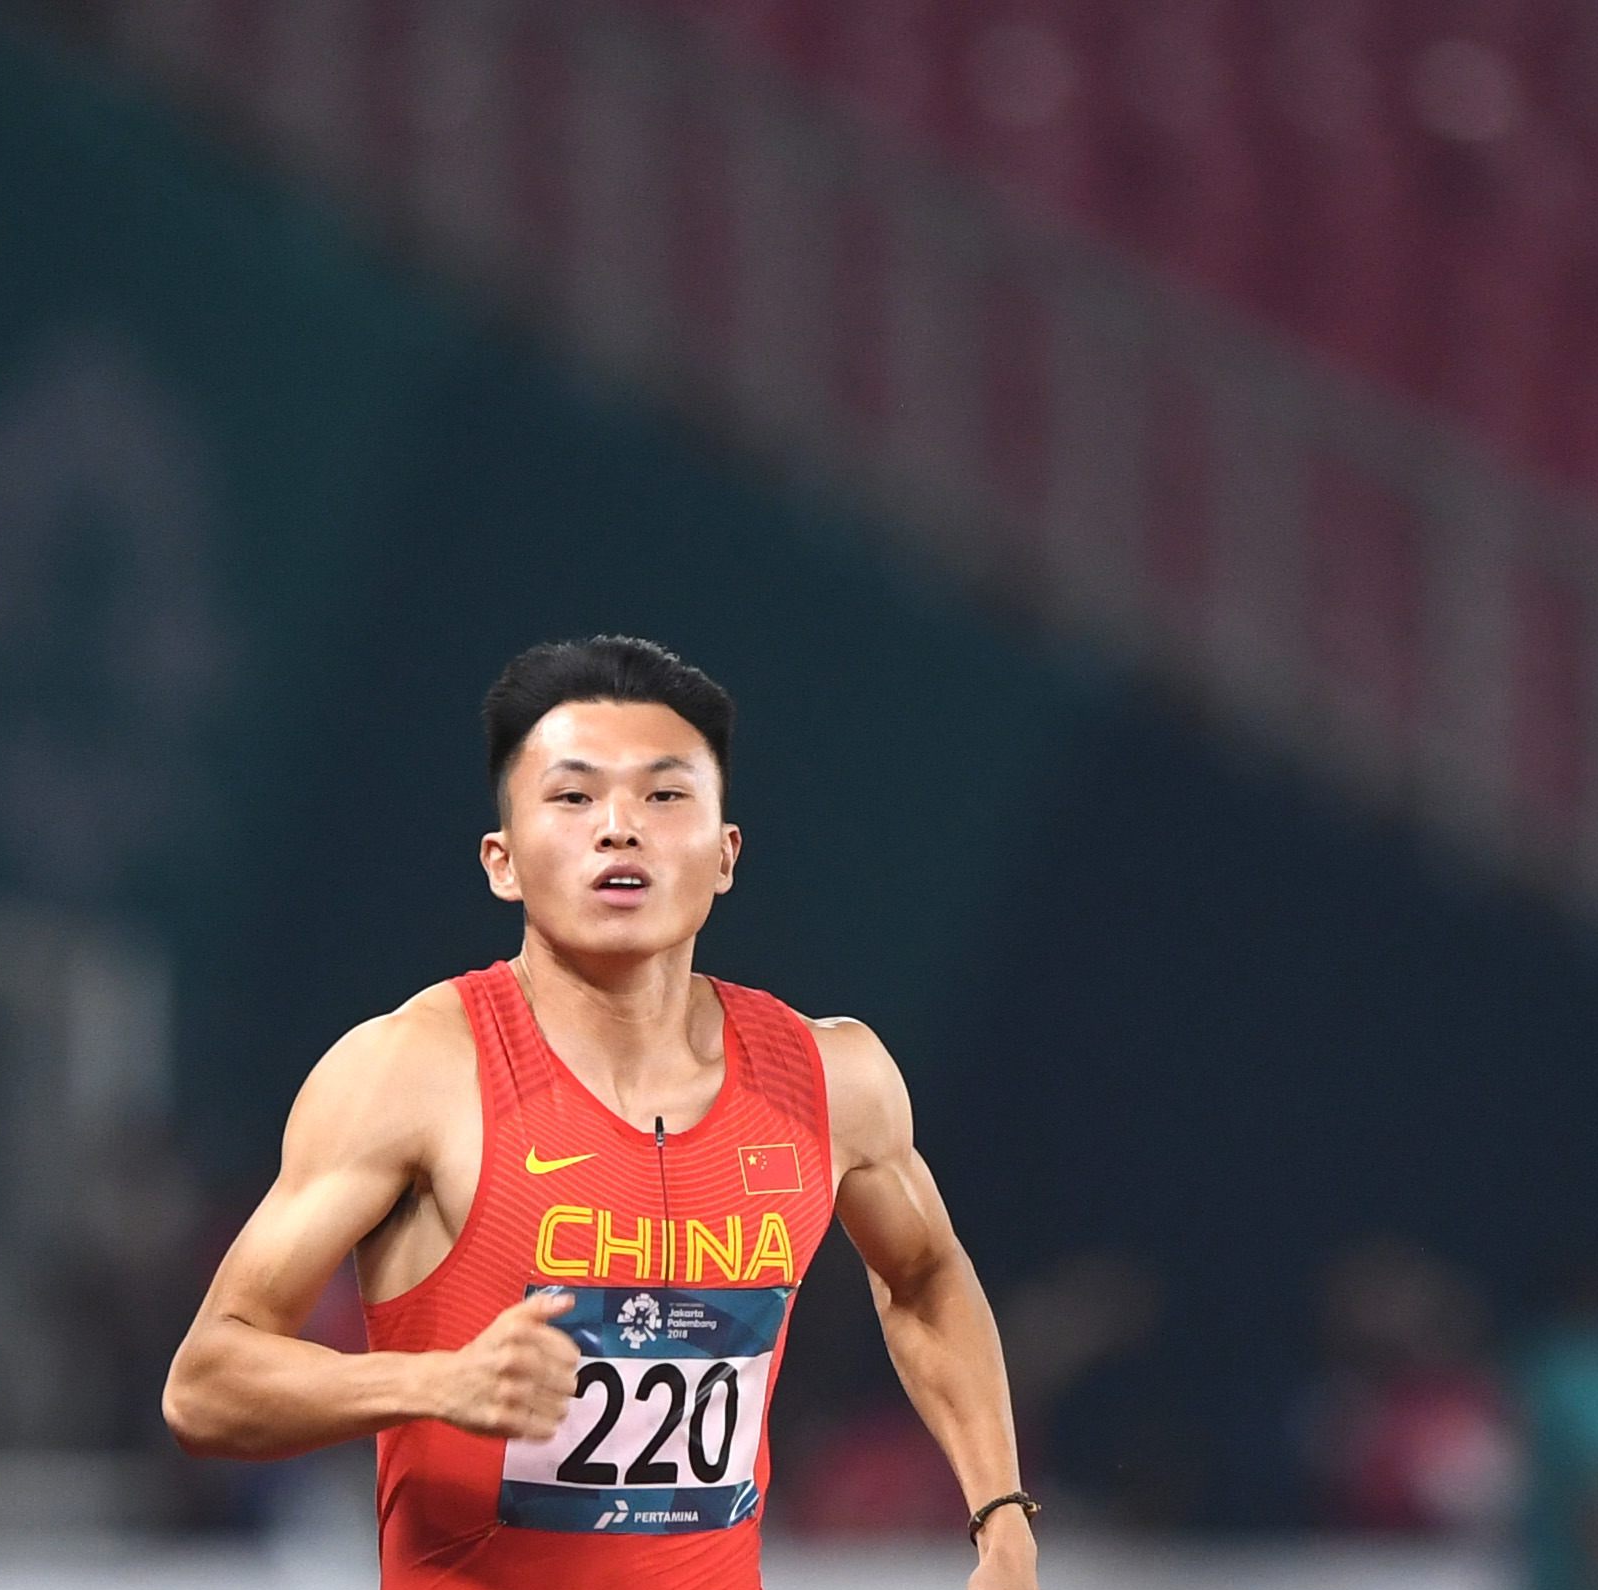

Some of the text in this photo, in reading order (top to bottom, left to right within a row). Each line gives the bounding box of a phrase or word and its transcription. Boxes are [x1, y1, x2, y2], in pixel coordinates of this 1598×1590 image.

[535, 1205, 794, 1283] CHINA
[668, 1308, 704, 1319] Jakarta
[667, 1318, 718, 1331] Palembang
[667, 1329, 688, 1339] 2018
[556, 1361, 739, 1485] 220
[633, 1511, 699, 1523] PERTAMINA
